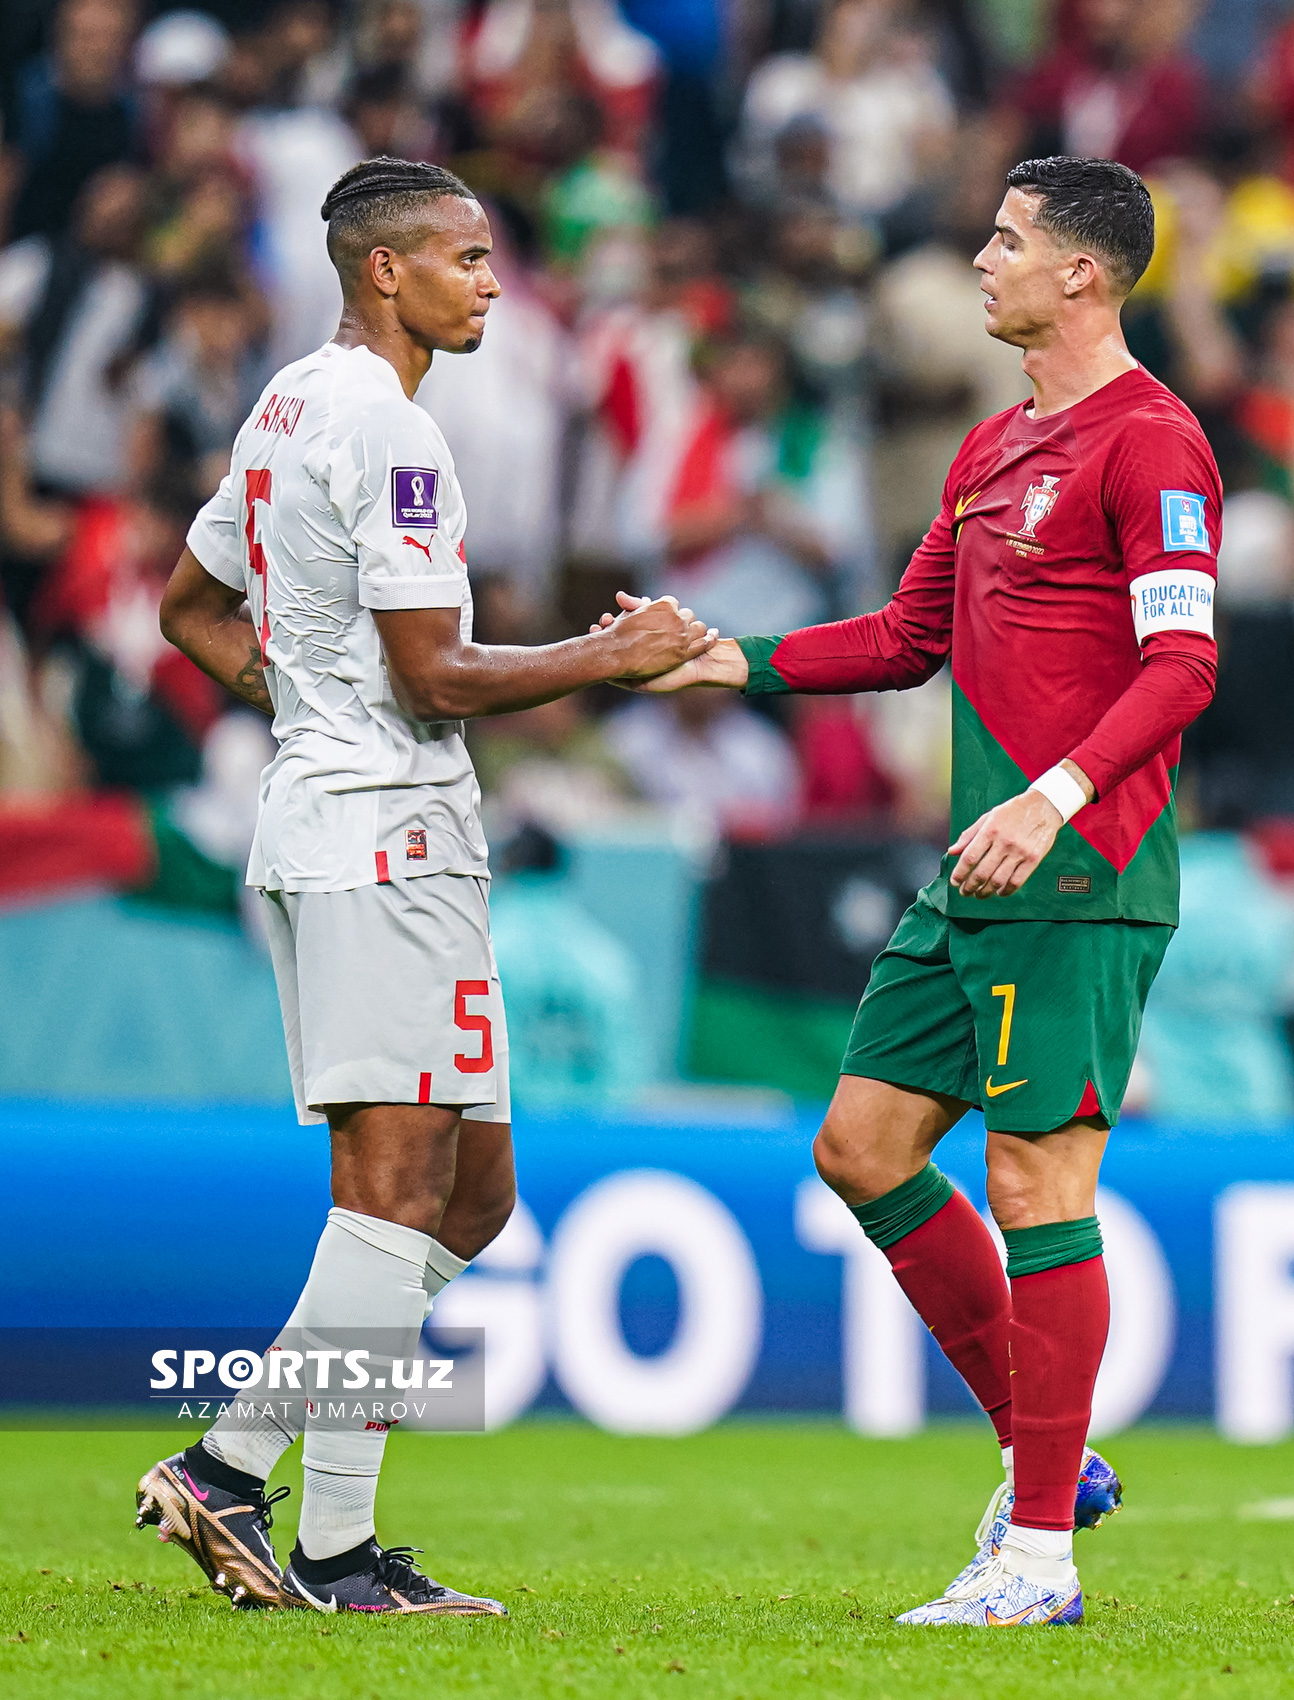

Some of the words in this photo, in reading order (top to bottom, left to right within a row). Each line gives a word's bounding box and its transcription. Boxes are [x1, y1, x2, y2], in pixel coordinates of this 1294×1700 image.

[1143, 602, 1166, 621] FOR
[1170, 601, 1195, 617] ALL
[453, 979, 495, 1074] 5
[991, 983, 1016, 1066] 7
